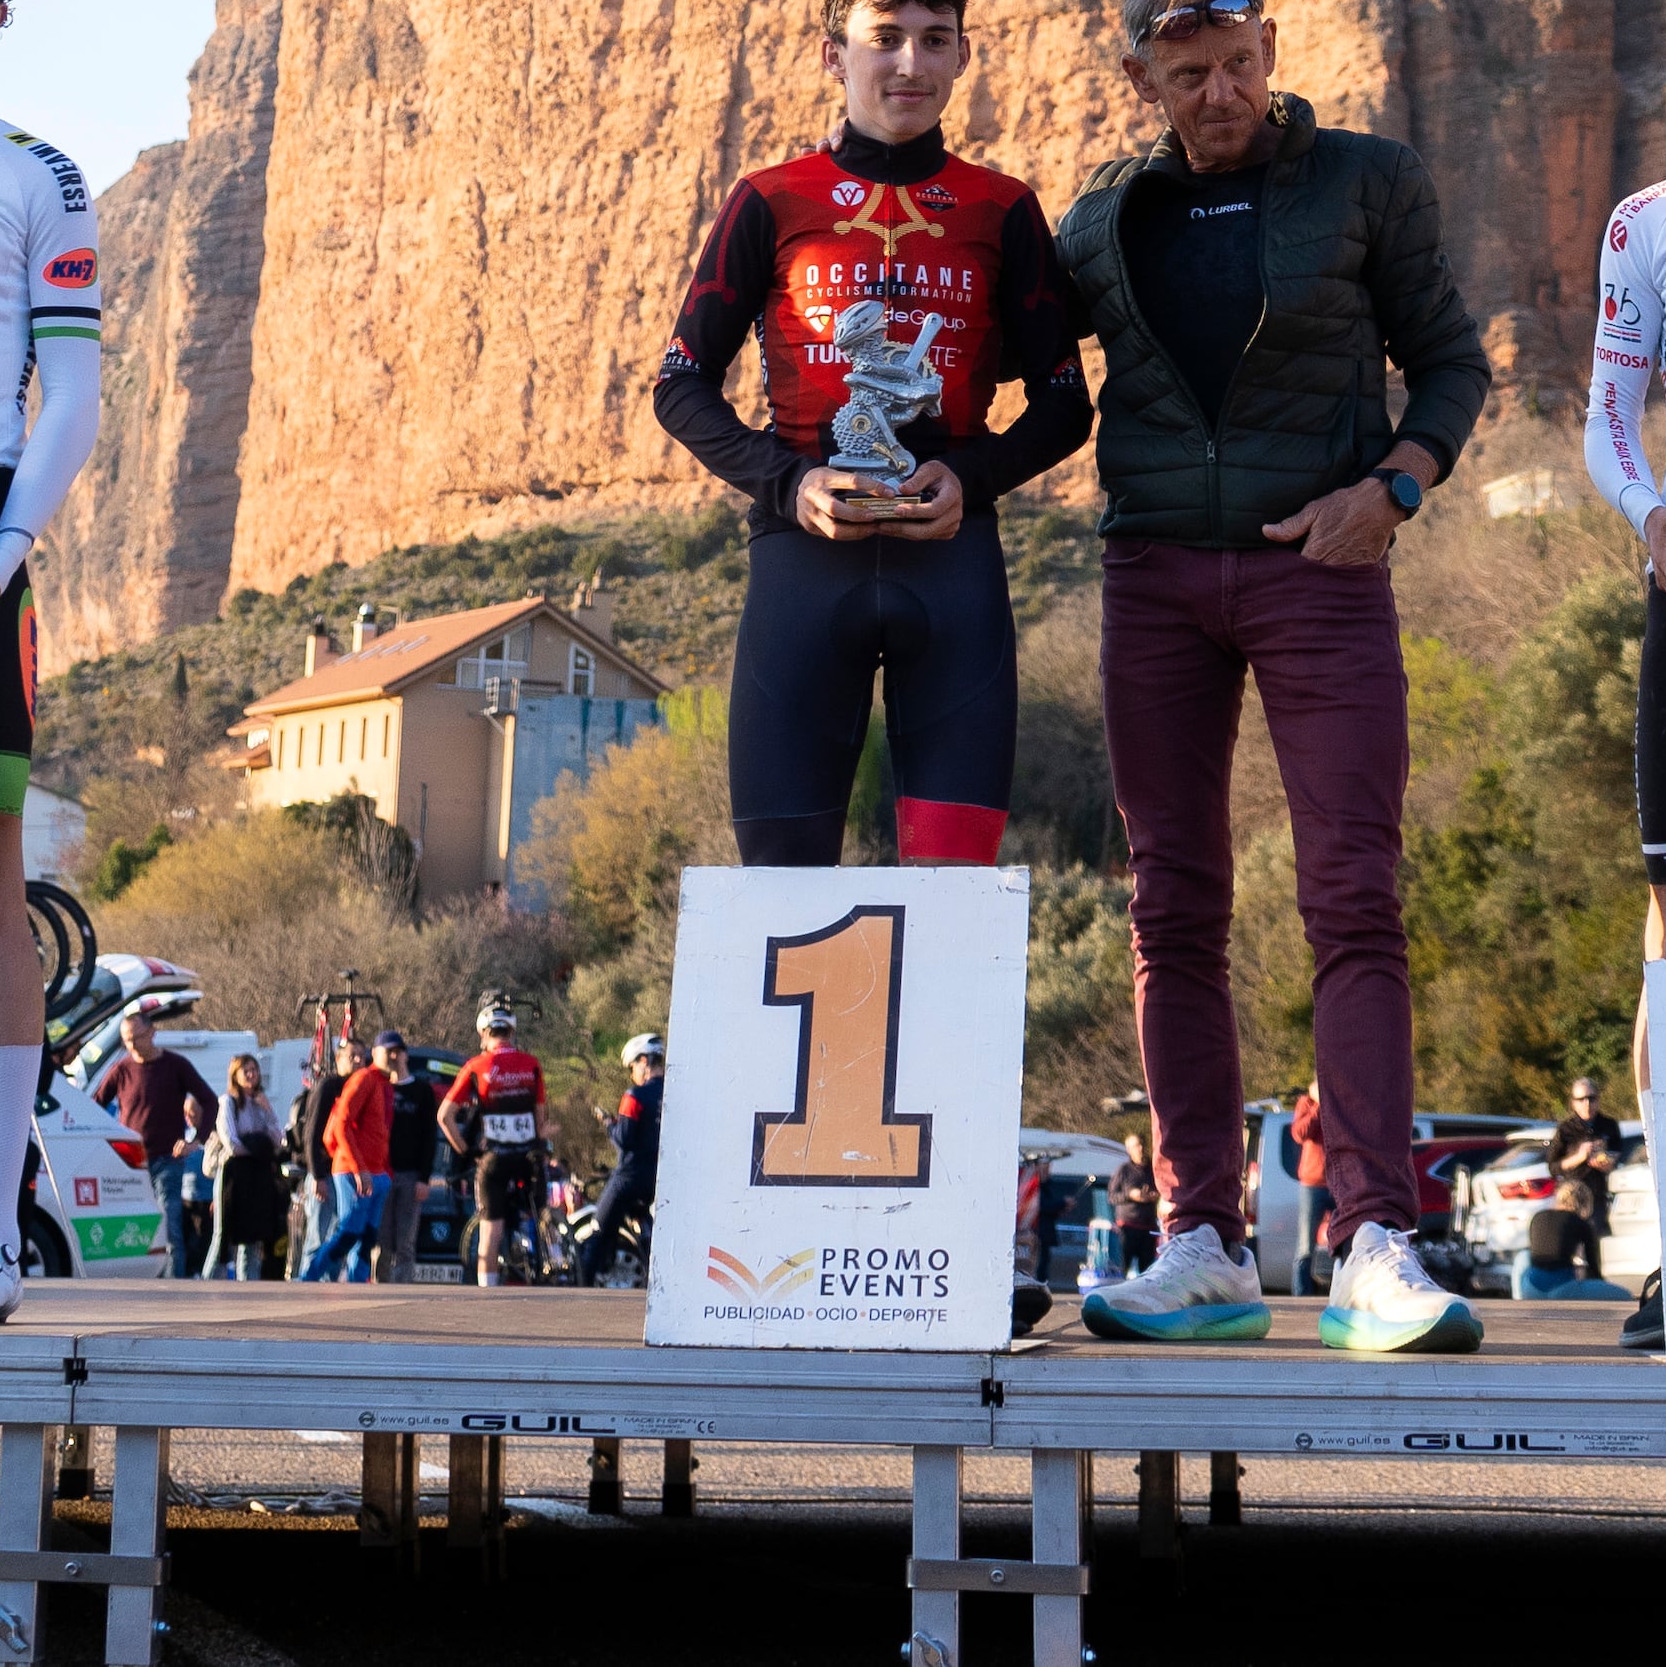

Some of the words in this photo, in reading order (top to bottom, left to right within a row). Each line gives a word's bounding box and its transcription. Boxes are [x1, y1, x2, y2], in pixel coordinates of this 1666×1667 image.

[1208, 202, 1253, 215] LURBEL
[806, 262, 973, 291] OCCITANE
[806, 286, 883, 299] CYCLISME
[892, 284, 972, 303] FORMATION
[1596, 346, 1649, 369] TORTOSA
[749, 904, 933, 1188] 1
[822, 1248, 951, 1272] PROMO
[820, 1273, 950, 1298] EVENTS
[704, 1305, 806, 1321] PUBLICIDAD
[815, 1306, 859, 1322] OCIO
[868, 1307, 948, 1323] DEPORTE
[379, 1414, 450, 1426] www.guil.es
[461, 1414, 617, 1434] GUIL
[1317, 1434, 1391, 1447] www.guil.es
[1403, 1433, 1566, 1452] GUIL
